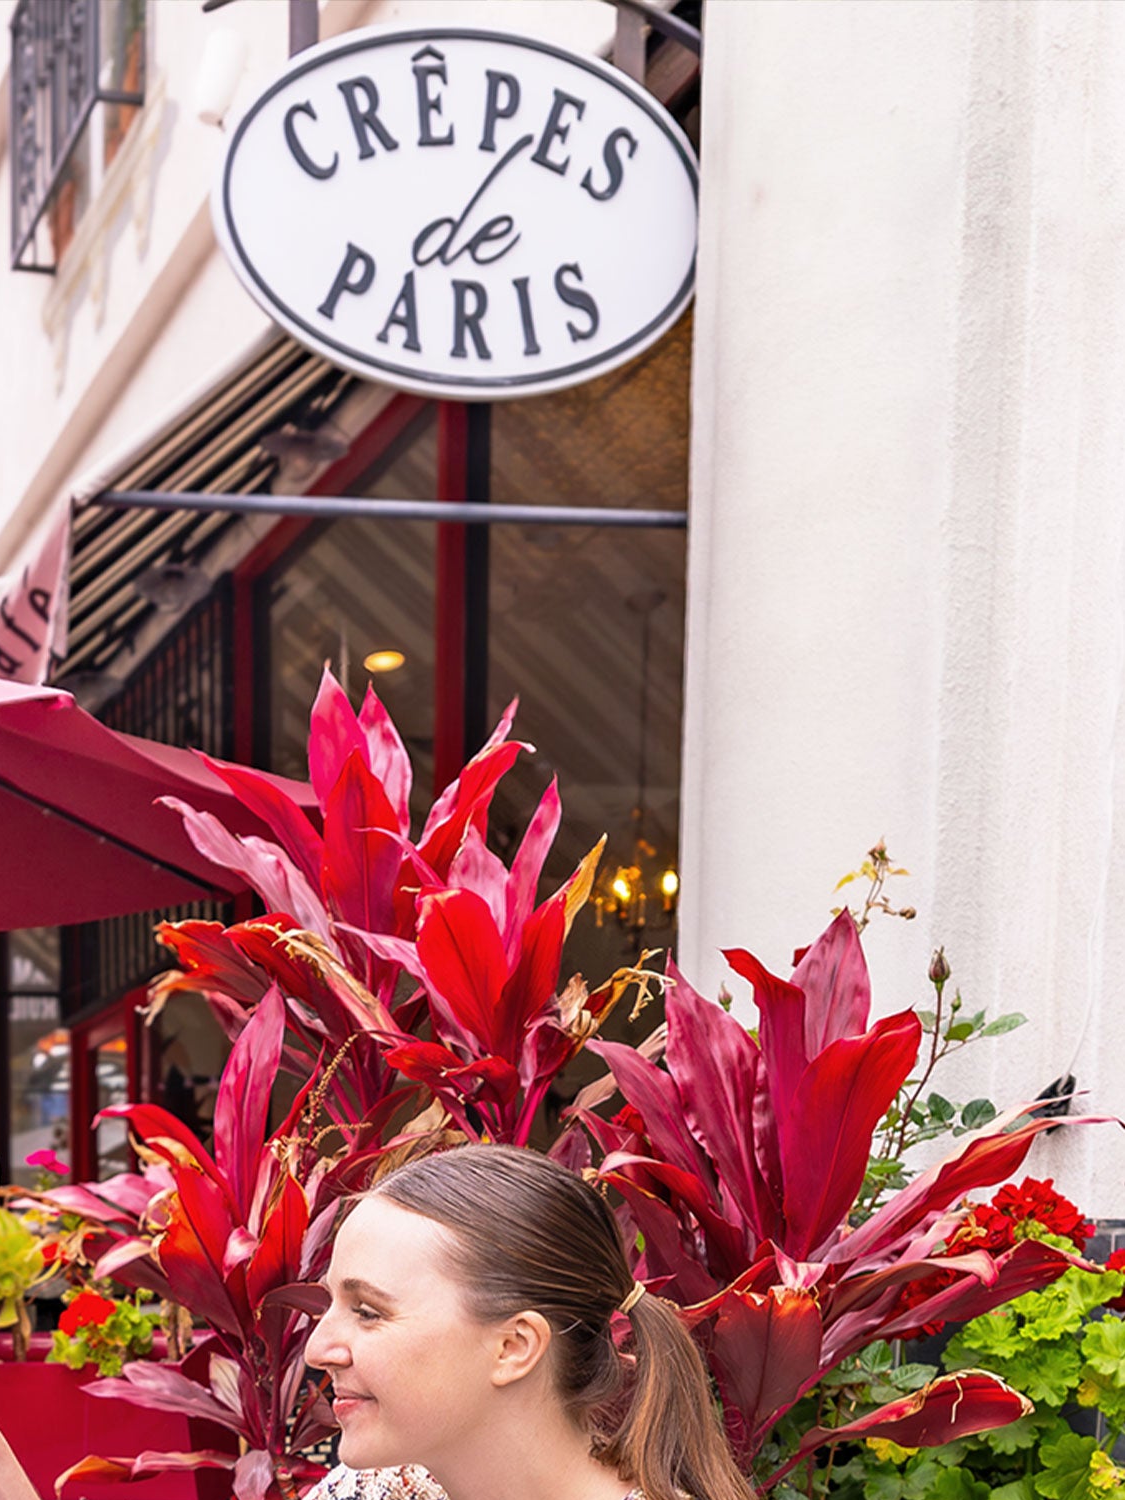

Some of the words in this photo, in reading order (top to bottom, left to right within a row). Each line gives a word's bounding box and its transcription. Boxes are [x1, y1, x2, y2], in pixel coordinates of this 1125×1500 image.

[283, 45, 638, 201] CRÊPES
[412, 134, 534, 268] de
[317, 242, 601, 361] PARIS
